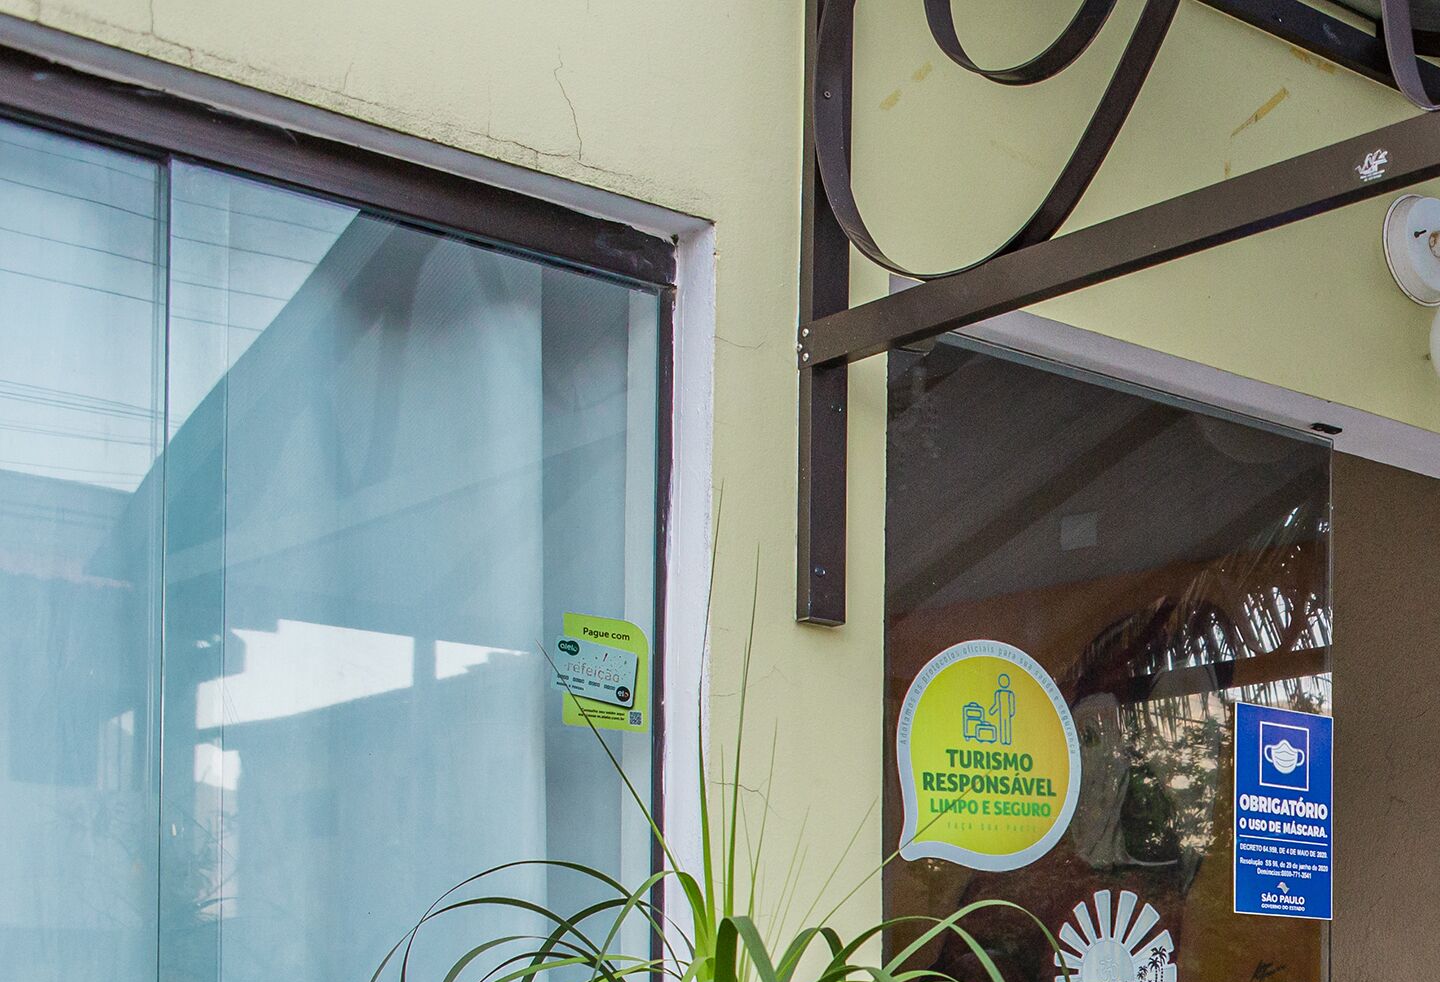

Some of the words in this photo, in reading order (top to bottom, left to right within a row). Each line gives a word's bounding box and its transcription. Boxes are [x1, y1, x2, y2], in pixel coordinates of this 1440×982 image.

[583, 627, 609, 639] Pague
[611, 632, 630, 641] com
[566, 661, 620, 683] refeição
[946, 749, 1033, 772] TURISMO
[922, 771, 1057, 797] RESPONSÁVEL
[930, 798, 978, 815] LIMPO
[982, 800, 991, 815] E
[994, 801, 1051, 817] SEGURO
[1239, 794, 1328, 820] OBRIGATÓRIO
[1239, 817, 1247, 829] O
[1248, 818, 1267, 831] USO
[1268, 821, 1281, 833] DE
[1283, 821, 1328, 838] MÁSCARA.
[1240, 843, 1262, 852] DECRETO
[1290, 848, 1297, 856] DE
[1297, 849, 1309, 857] MAIO
[1240, 857, 1263, 866] Resolução
[1261, 892, 1278, 902] SÃO
[1279, 895, 1305, 905] PAULO
